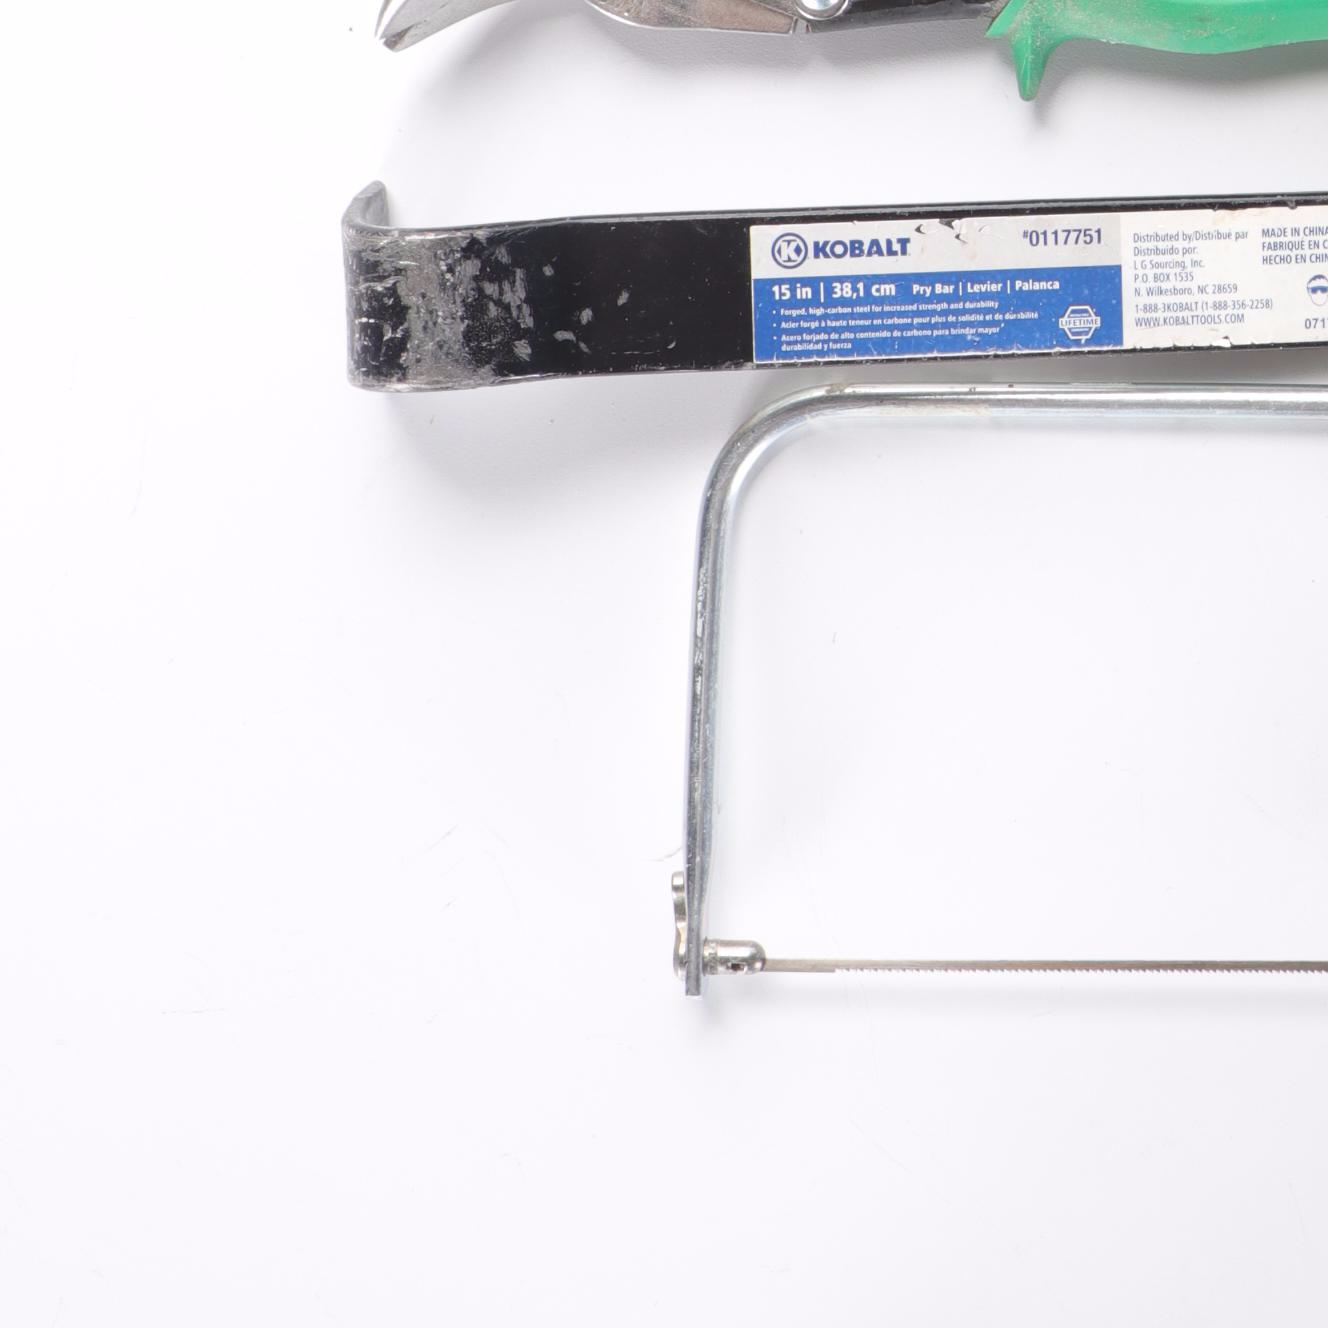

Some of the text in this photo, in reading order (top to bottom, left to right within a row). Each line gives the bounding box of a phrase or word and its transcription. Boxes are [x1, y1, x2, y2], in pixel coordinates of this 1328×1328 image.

[1023, 228, 1102, 247] #0117751
[1133, 231, 1180, 243] Distributed
[1235, 230, 1249, 241] par
[1261, 227, 1288, 238] MADE
[1291, 227, 1300, 237] IN
[813, 238, 911, 259] KOBALT
[1133, 245, 1180, 257] Distribuido
[1308, 239, 1320, 250] EN
[1134, 260, 1138, 270] L
[1140, 260, 1147, 270] G
[1190, 258, 1206, 268] Inc.
[1262, 254, 1292, 265] HECHO
[1295, 253, 1306, 264] EN
[1153, 272, 1171, 283] BOX
[1174, 271, 1195, 281] 1535
[772, 285, 791, 300] 15
[796, 284, 812, 299] in
[831, 282, 865, 299] 38,1
[871, 283, 896, 297] cm
[912, 284, 931, 297] Pry
[935, 283, 954, 295] Bar
[967, 281, 1003, 293] Levier
[1015, 279, 1060, 291] Palanca
[1134, 283, 1238, 297] N. Wilkesboro, NC 28659
[809, 304, 852, 316] high-carbon
[853, 304, 870, 313] steel
[872, 304, 882, 312] for
[883, 302, 918, 312] increased
[919, 301, 948, 312] strength
[949, 301, 963, 309] and
[964, 299, 999, 309] durability
[1135, 298, 1273, 313] 1-888-3KOBALT (1-888-356-2258)
[780, 321, 799, 329] Acier
[827, 318, 847, 327] haute
[849, 318, 872, 327] teneur
[883, 315, 912, 325] carbone
[913, 317, 930, 326] pour
[931, 315, 946, 324] plus
[947, 314, 956, 322] de
[958, 312, 984, 322] solidité
[985, 313, 993, 321] et
[994, 312, 1003, 321] de
[1135, 313, 1245, 327] WWW.KOBALTTOOLS.COM
[803, 332, 828, 343] forjado
[830, 331, 840, 340] de
[841, 331, 855, 340] alto
[856, 328, 891, 339] contenido
[893, 328, 901, 337] de
[903, 327, 932, 337] carbono
[933, 328, 949, 337] para
[950, 325, 976, 335] brindar
[977, 326, 1000, 335] mayor
[781, 341, 852, 351] durabilidad y fuerza
